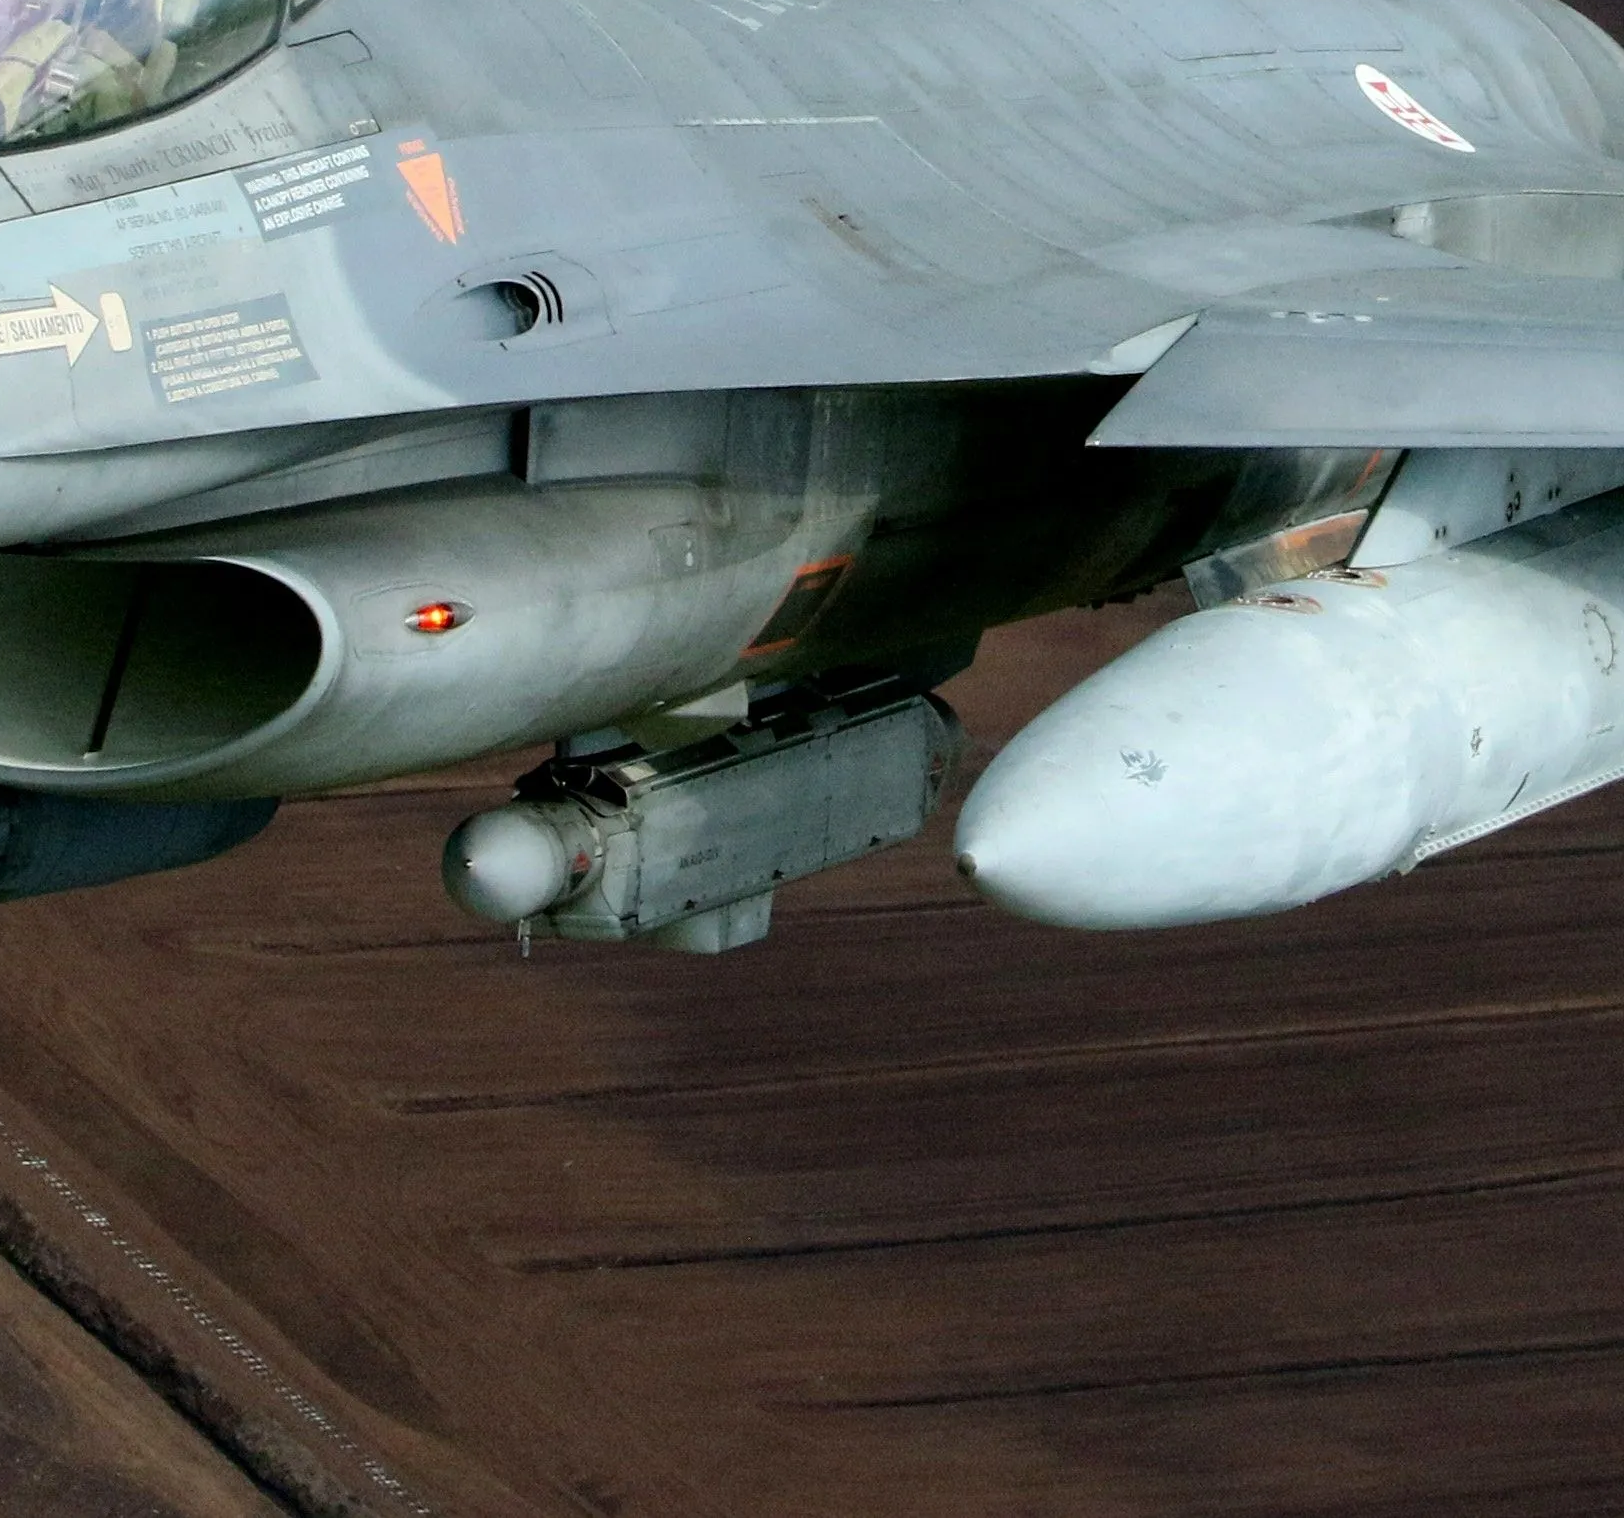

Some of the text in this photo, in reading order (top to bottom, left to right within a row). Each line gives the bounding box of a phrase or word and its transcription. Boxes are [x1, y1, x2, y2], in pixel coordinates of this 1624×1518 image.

[279, 167, 301, 182] THIS
[297, 155, 335, 178] AIRCRAFT
[332, 144, 370, 167] CONTAINS
[254, 164, 370, 213] A CANOPY REMOVER CONTAINING
[262, 192, 346, 232] AN EXPLOSIVE CHARGE
